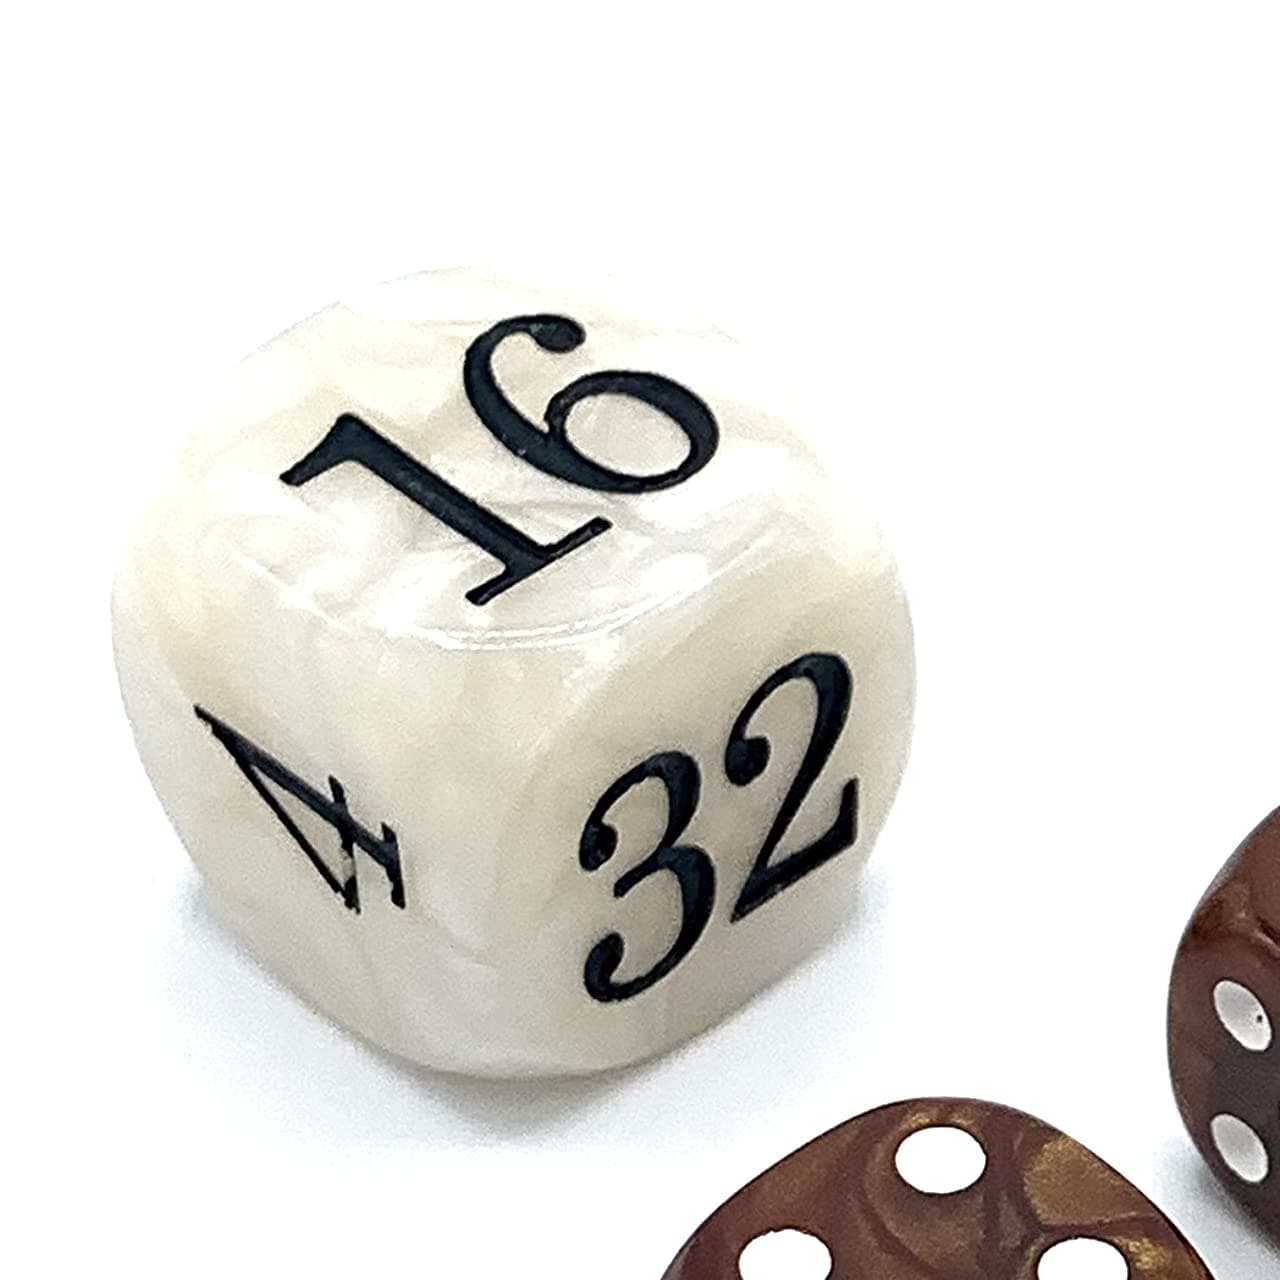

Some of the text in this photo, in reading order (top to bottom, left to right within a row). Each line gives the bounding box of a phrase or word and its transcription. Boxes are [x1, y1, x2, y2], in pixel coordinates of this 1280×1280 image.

[279, 313, 720, 607] 16
[193, 704, 407, 915] 4
[578, 651, 860, 1004] 32
